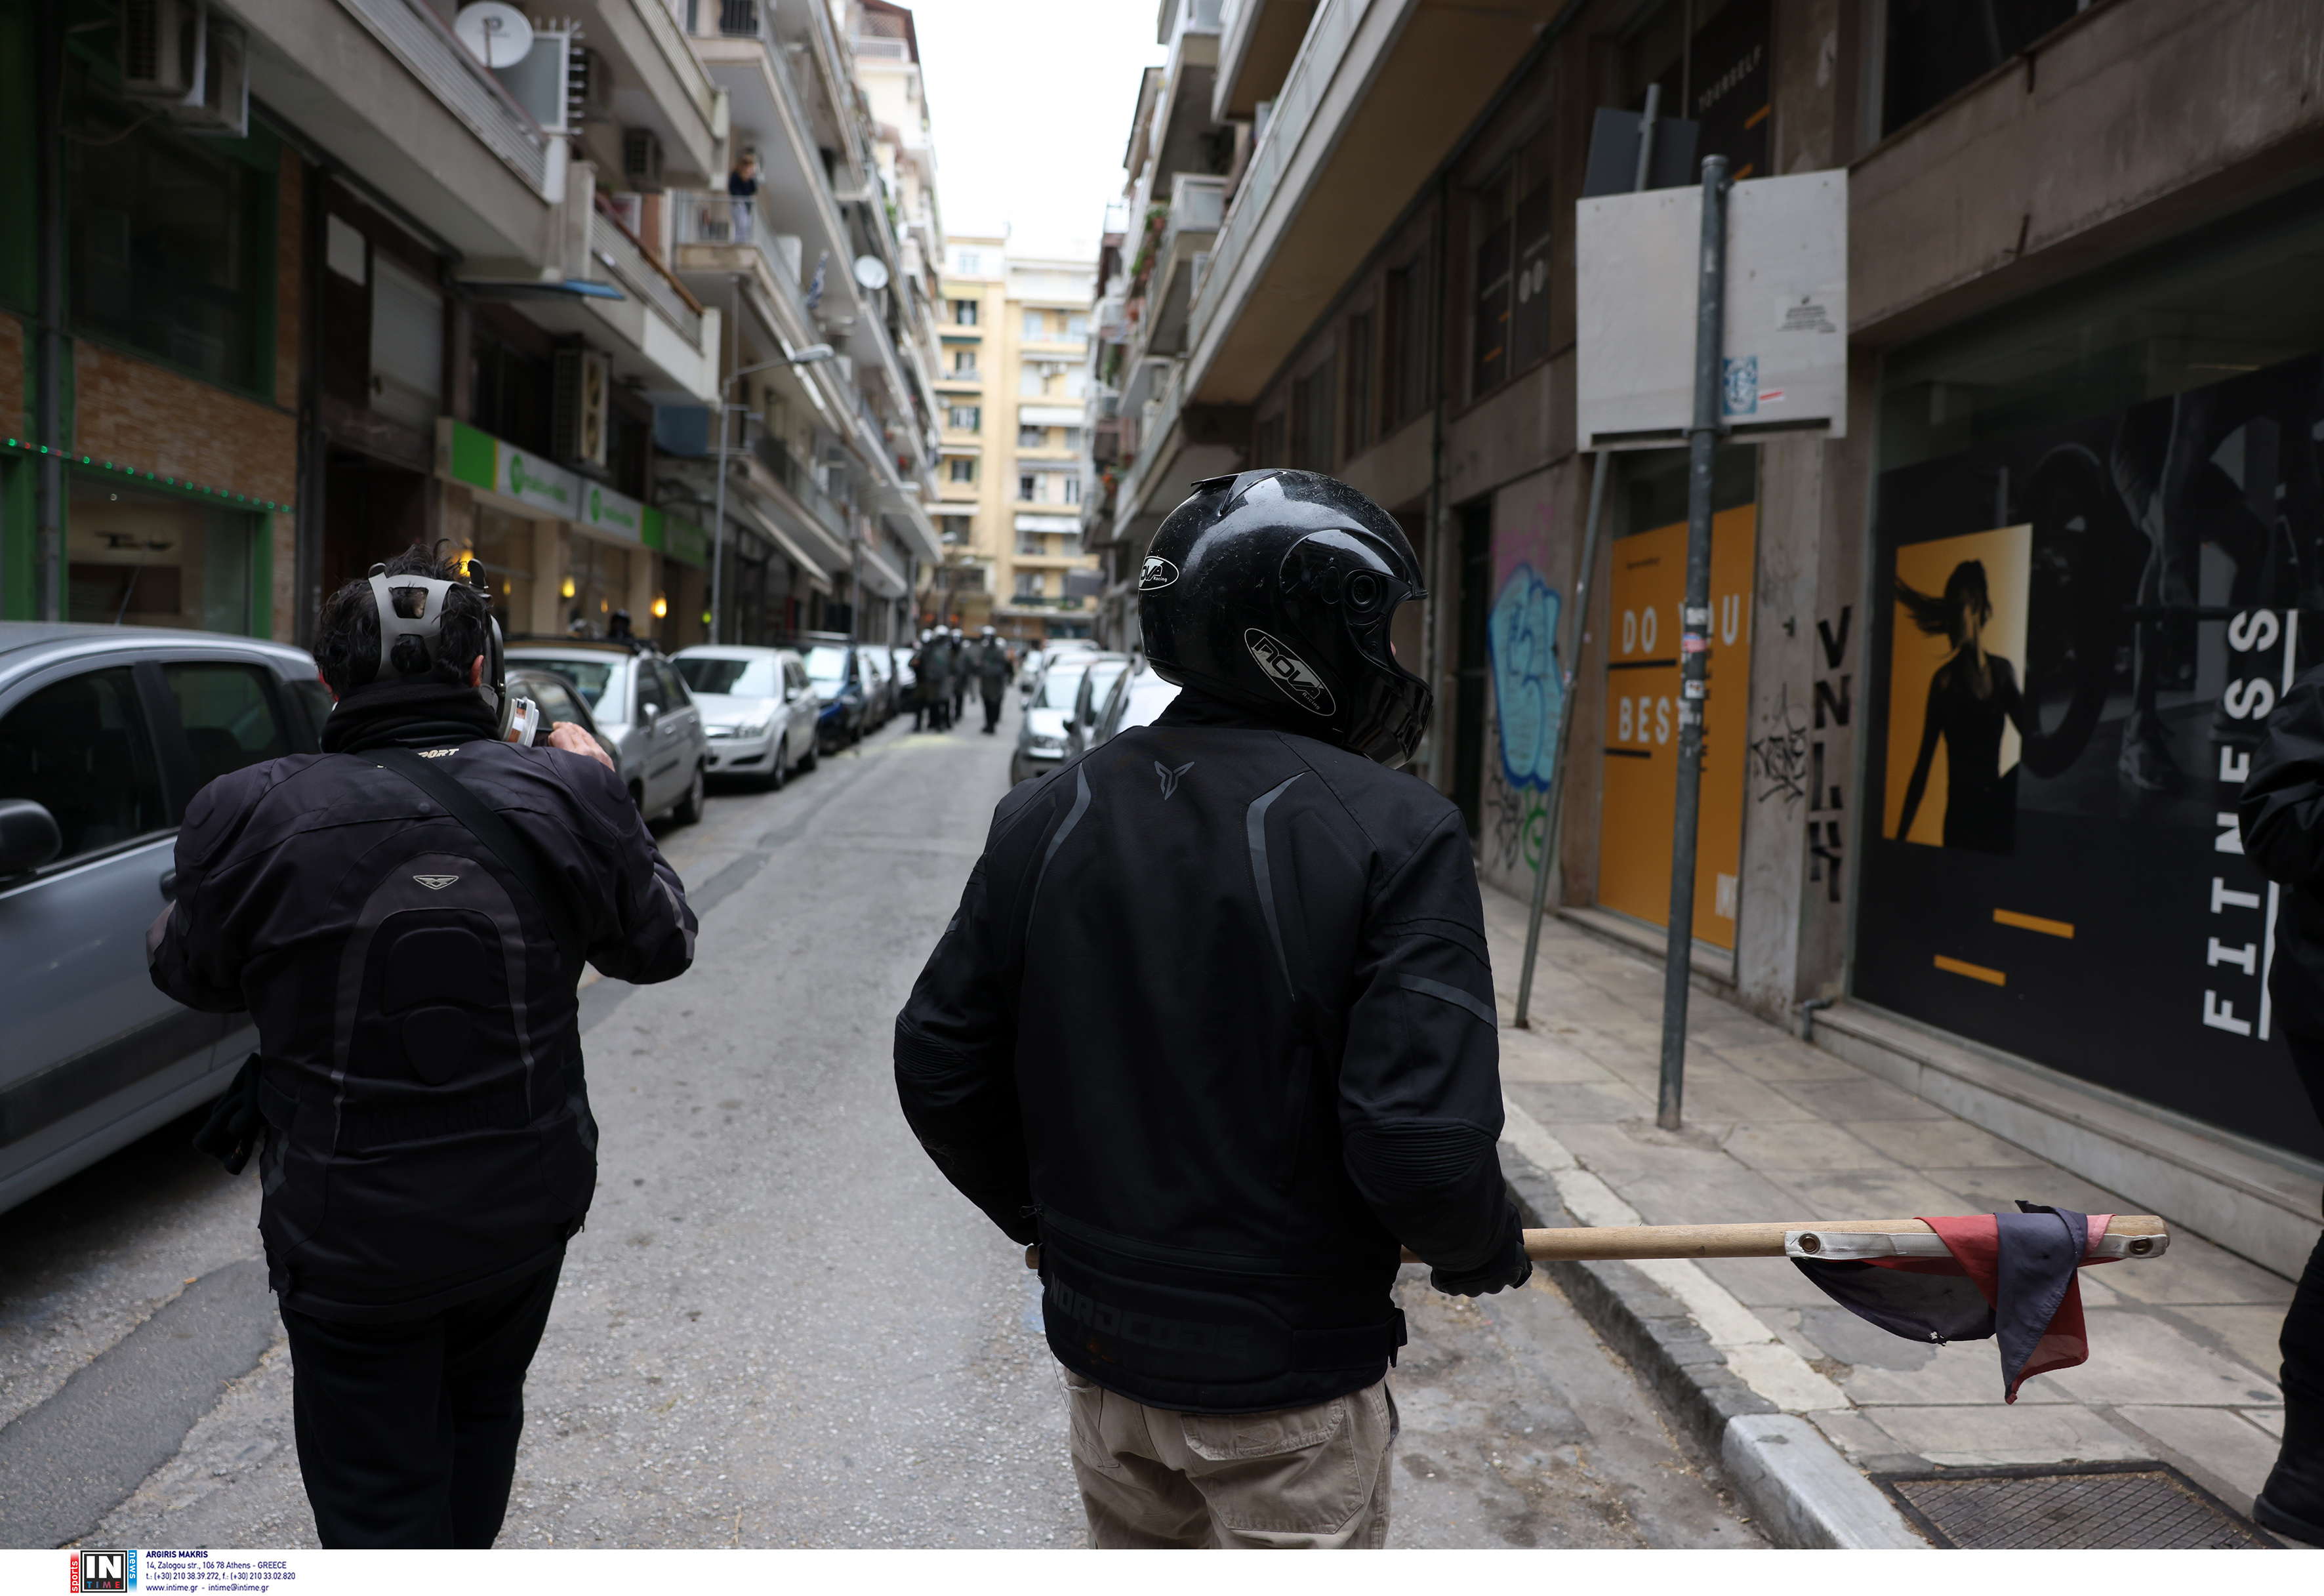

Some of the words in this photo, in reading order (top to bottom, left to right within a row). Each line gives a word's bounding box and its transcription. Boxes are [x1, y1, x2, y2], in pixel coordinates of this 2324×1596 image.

[1141, 565, 1163, 582] OVA
[1622, 605, 1658, 655] DO
[1301, 691, 1320, 710] Racing
[1618, 695, 1683, 747] BES
[418, 748, 460, 759] PORT
[2203, 608, 2279, 1036] FITNESS
[1050, 1271, 1254, 1358] NORDCODE
